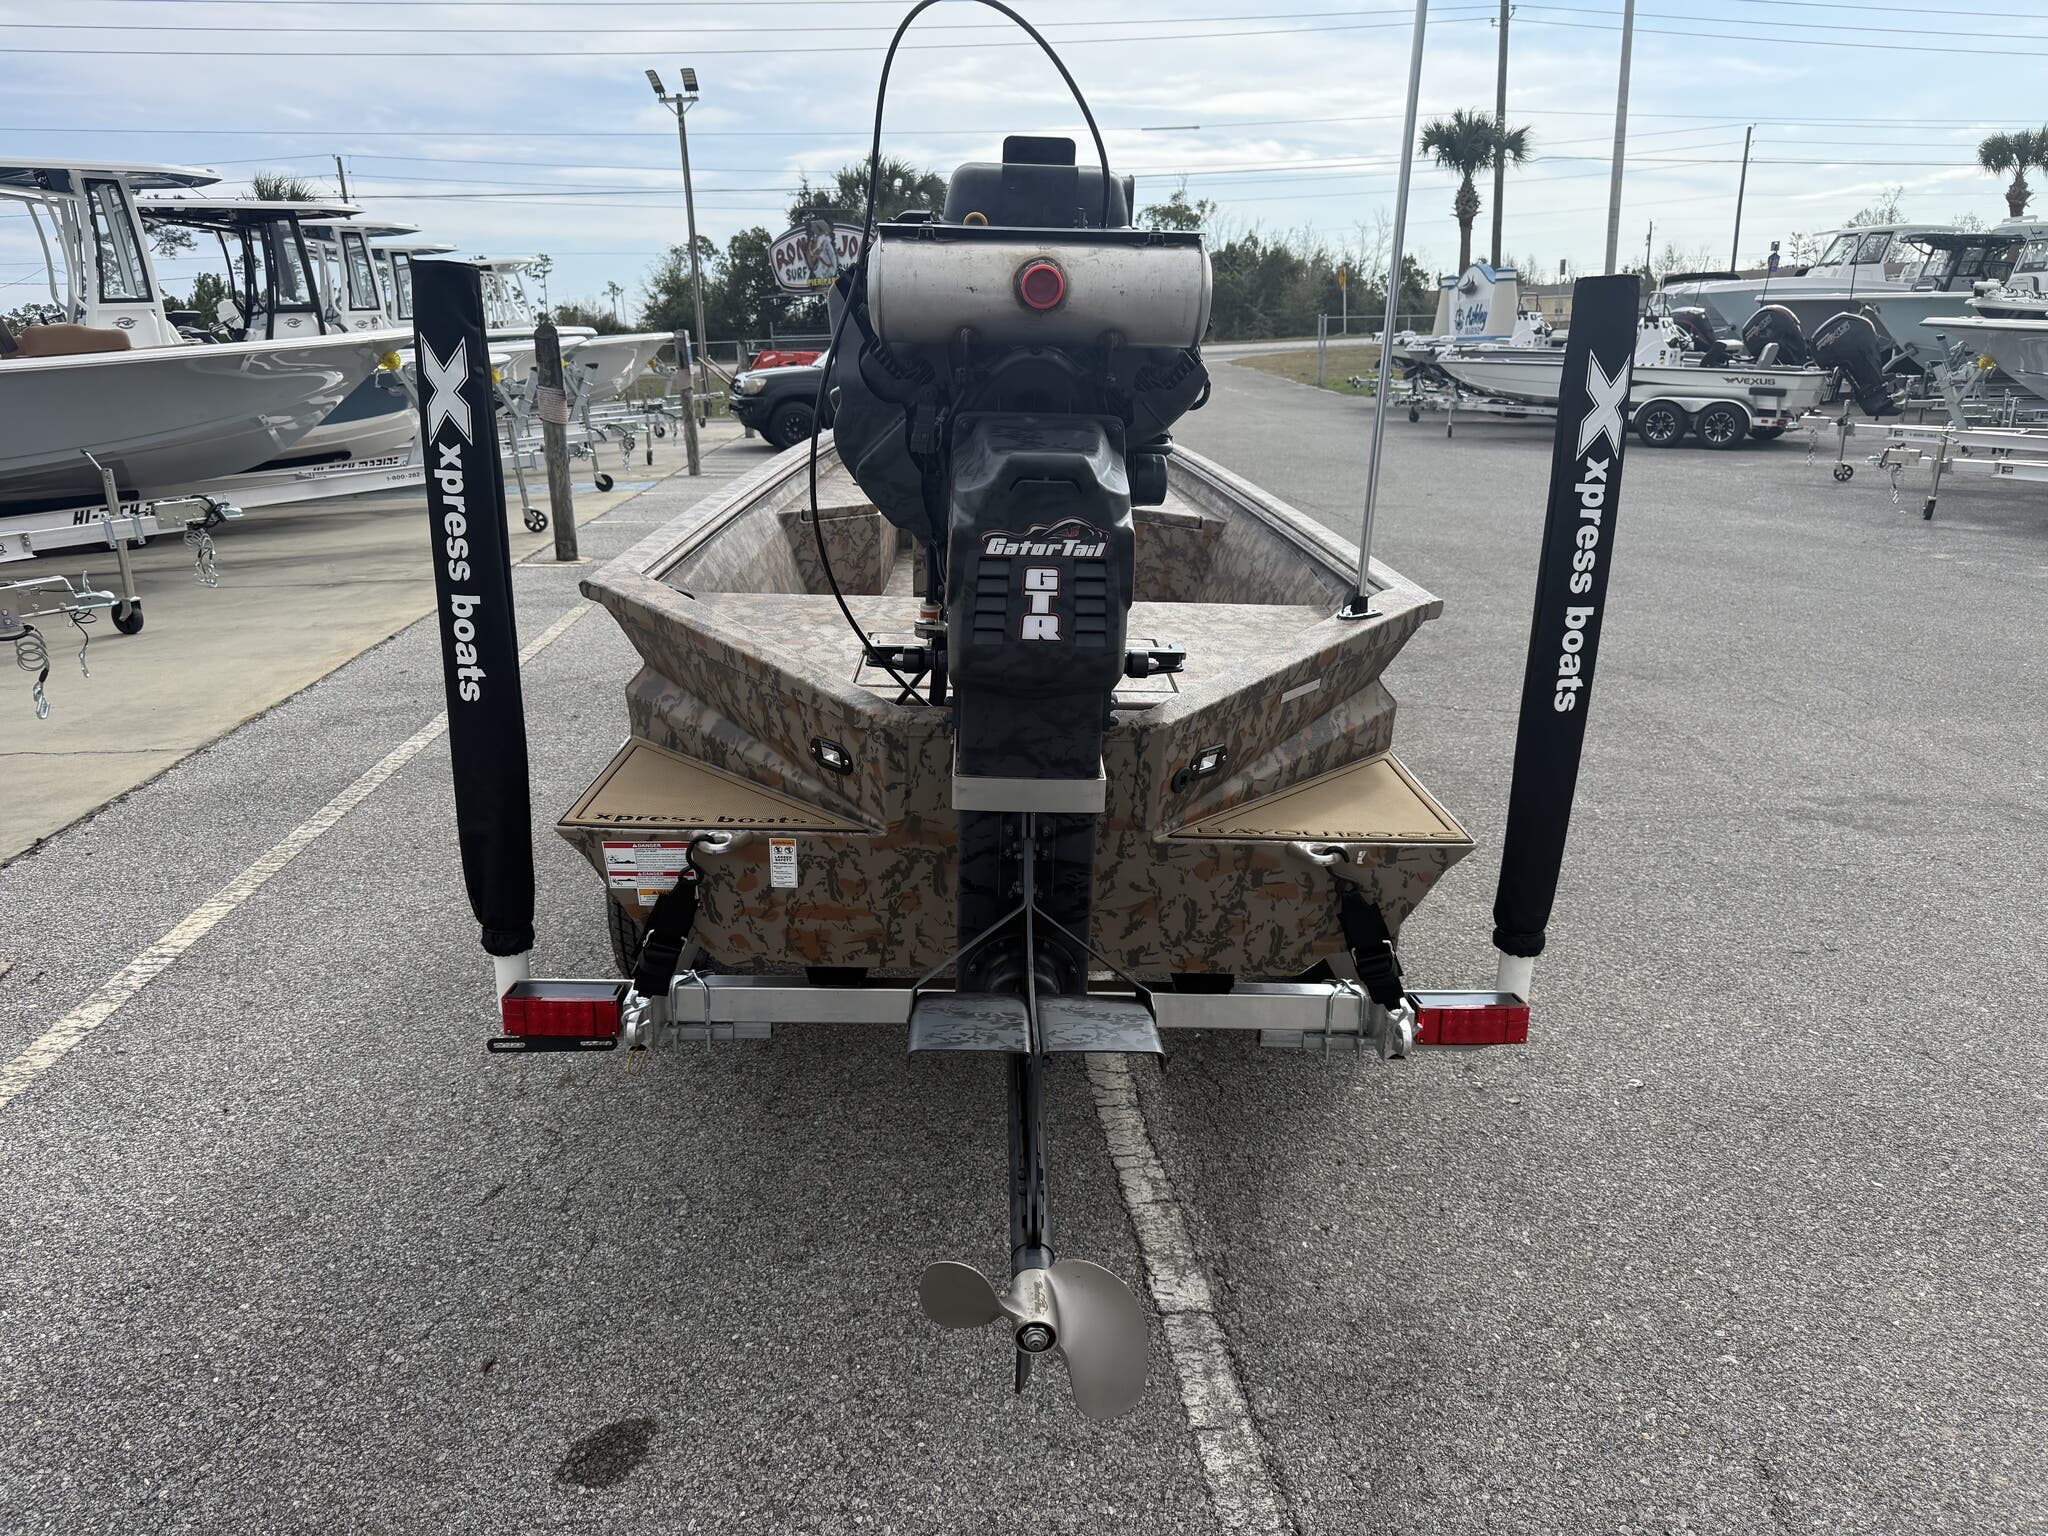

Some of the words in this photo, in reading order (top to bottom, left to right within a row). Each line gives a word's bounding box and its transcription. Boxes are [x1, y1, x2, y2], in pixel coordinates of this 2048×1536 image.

[786, 266, 808, 281] SURF
[1735, 376, 1776, 386] VEXUS
[433, 441, 470, 582] xpress
[1569, 456, 1611, 593] xpress
[450, 593, 487, 702] boats
[1021, 568, 1062, 641] GTR
[1553, 605, 1594, 712] boats
[593, 812, 706, 825] xpress
[717, 815, 807, 825] boats
